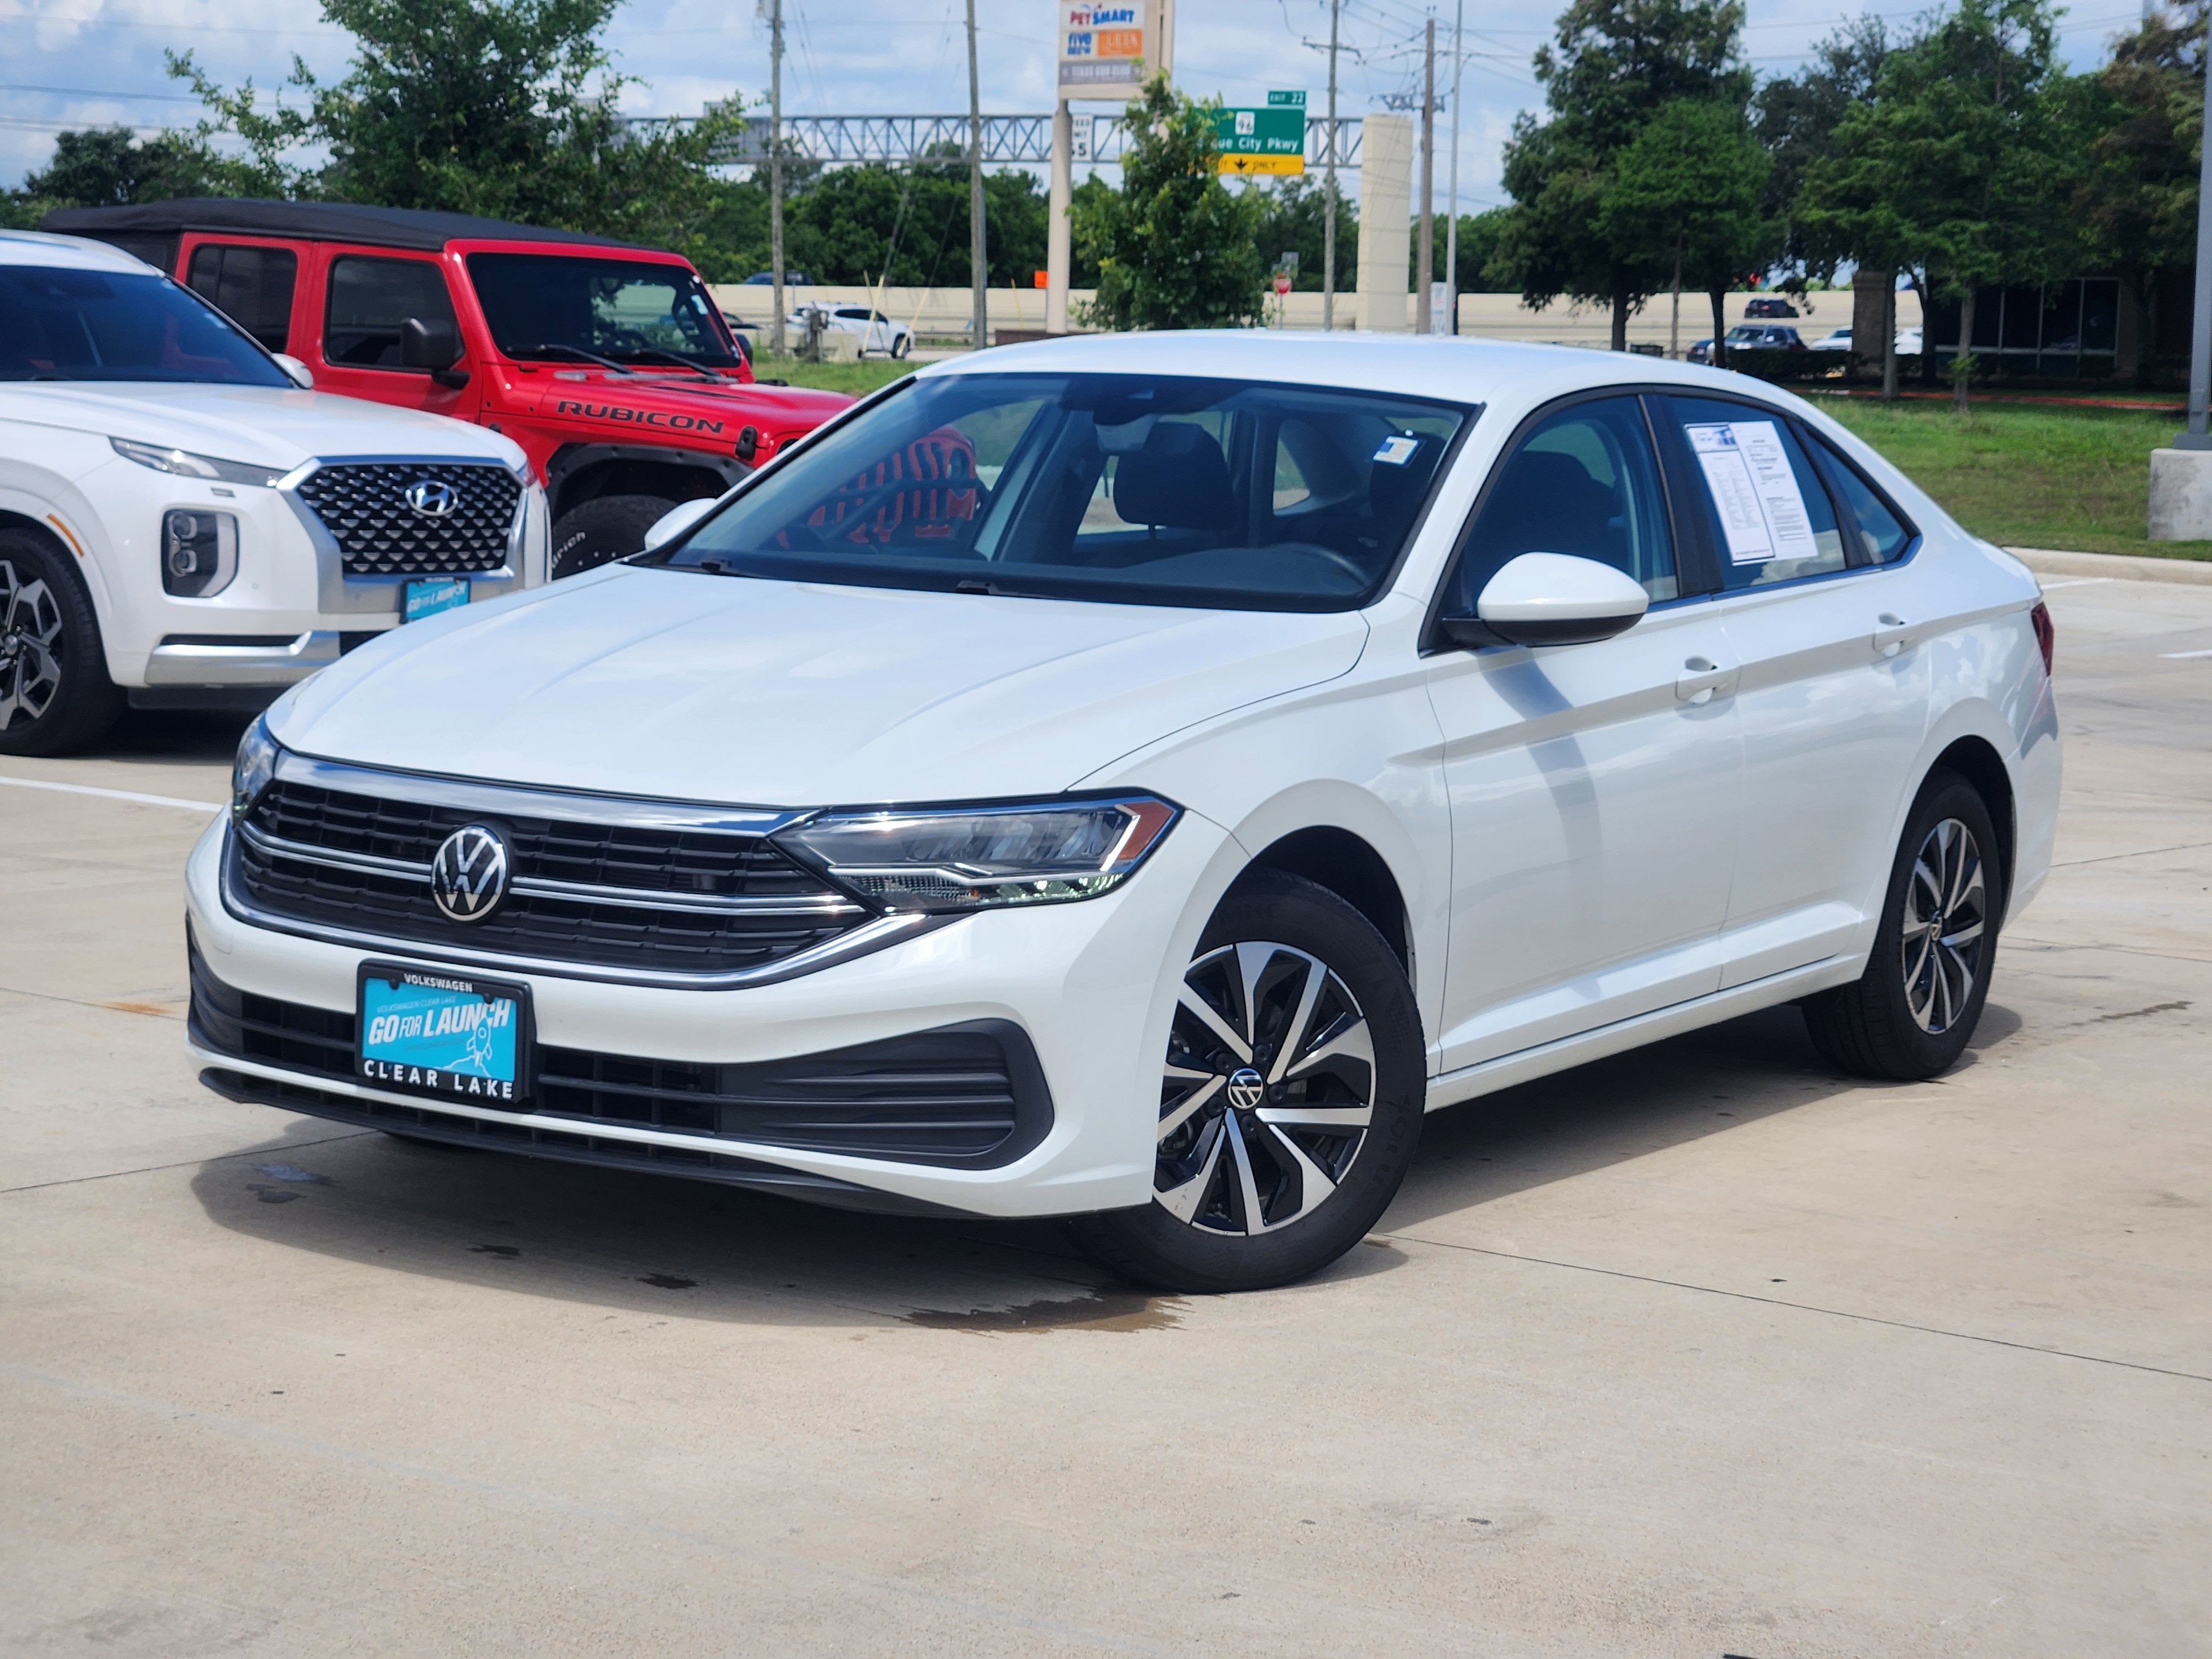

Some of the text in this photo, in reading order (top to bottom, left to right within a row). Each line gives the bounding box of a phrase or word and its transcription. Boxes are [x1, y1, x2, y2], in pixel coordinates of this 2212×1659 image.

[1291, 91, 1304, 104] 22
[1238, 137, 1262, 152] City
[1266, 137, 1299, 153] Pkwy
[557, 400, 724, 434] RUBICON
[403, 973, 473, 993] VOLKSWAGEN
[368, 1014, 400, 1045] GO
[399, 1014, 422, 1039] FOR
[422, 998, 511, 1038] LAUNCH
[363, 1060, 513, 1099] CLEAR LAKE
